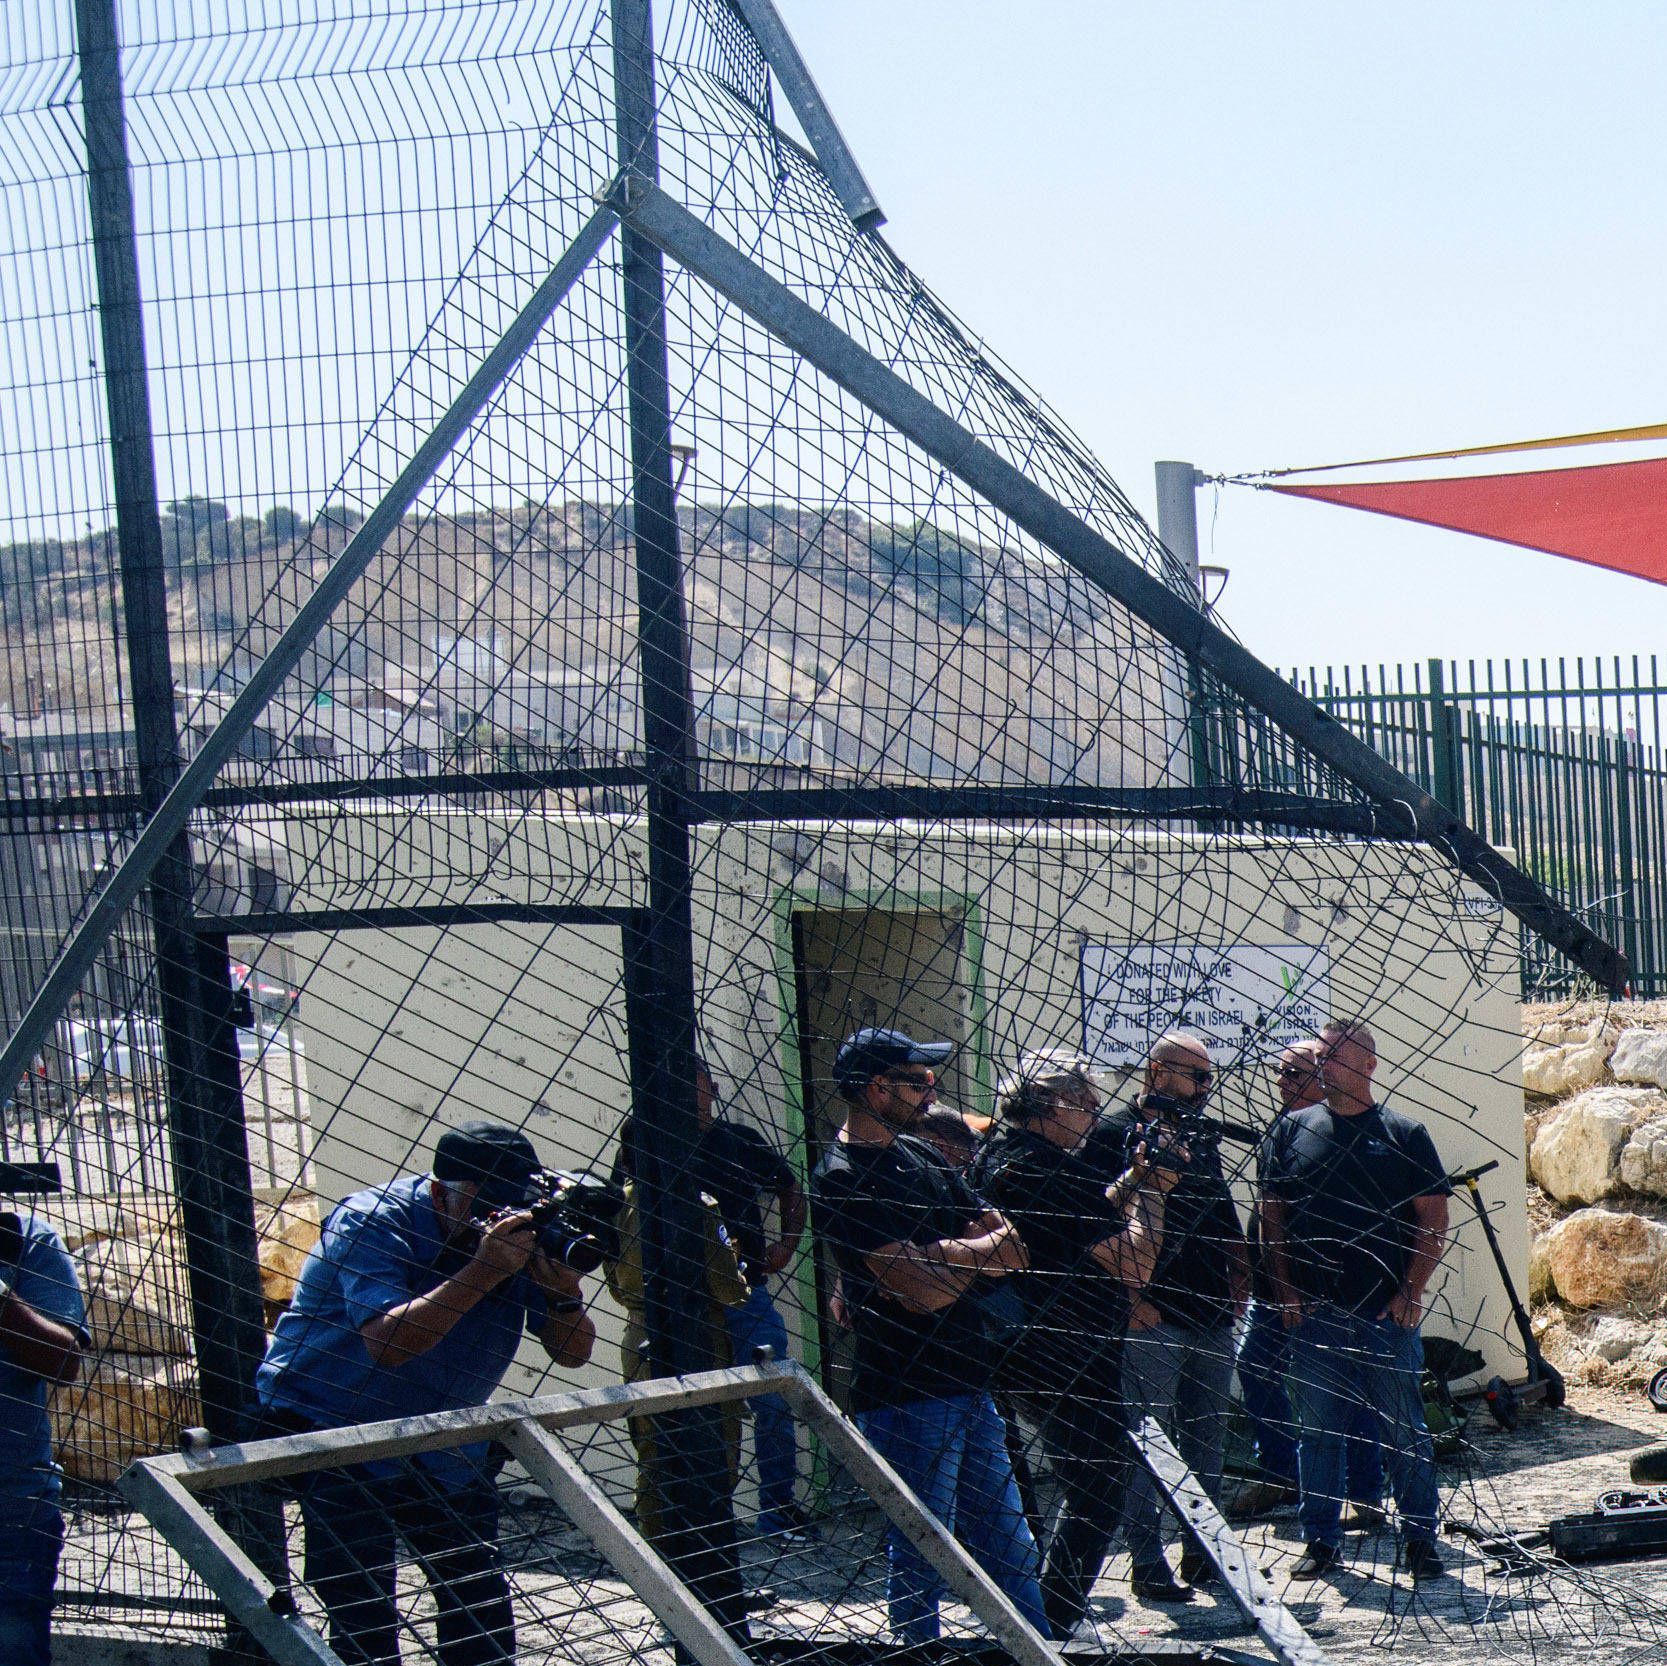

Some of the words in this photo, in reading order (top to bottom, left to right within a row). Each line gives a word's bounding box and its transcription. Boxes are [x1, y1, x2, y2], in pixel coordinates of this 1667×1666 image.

[1116, 963, 1170, 979] DONATED
[1173, 962, 1200, 978] WITH
[1203, 961, 1232, 977] LOVE
[1130, 988, 1151, 1004] FOR
[1156, 987, 1177, 1003] THE
[1181, 986, 1222, 1003] SAFETY
[1275, 1005, 1310, 1016] VISION
[1104, 1013, 1120, 1030] OF
[1125, 1013, 1146, 1029] THE
[1149, 1011, 1191, 1028] PEOPLE
[1195, 1011, 1206, 1027] IN
[1209, 1010, 1243, 1026] ISRAEL
[1283, 1018, 1319, 1029] ISRAEL
